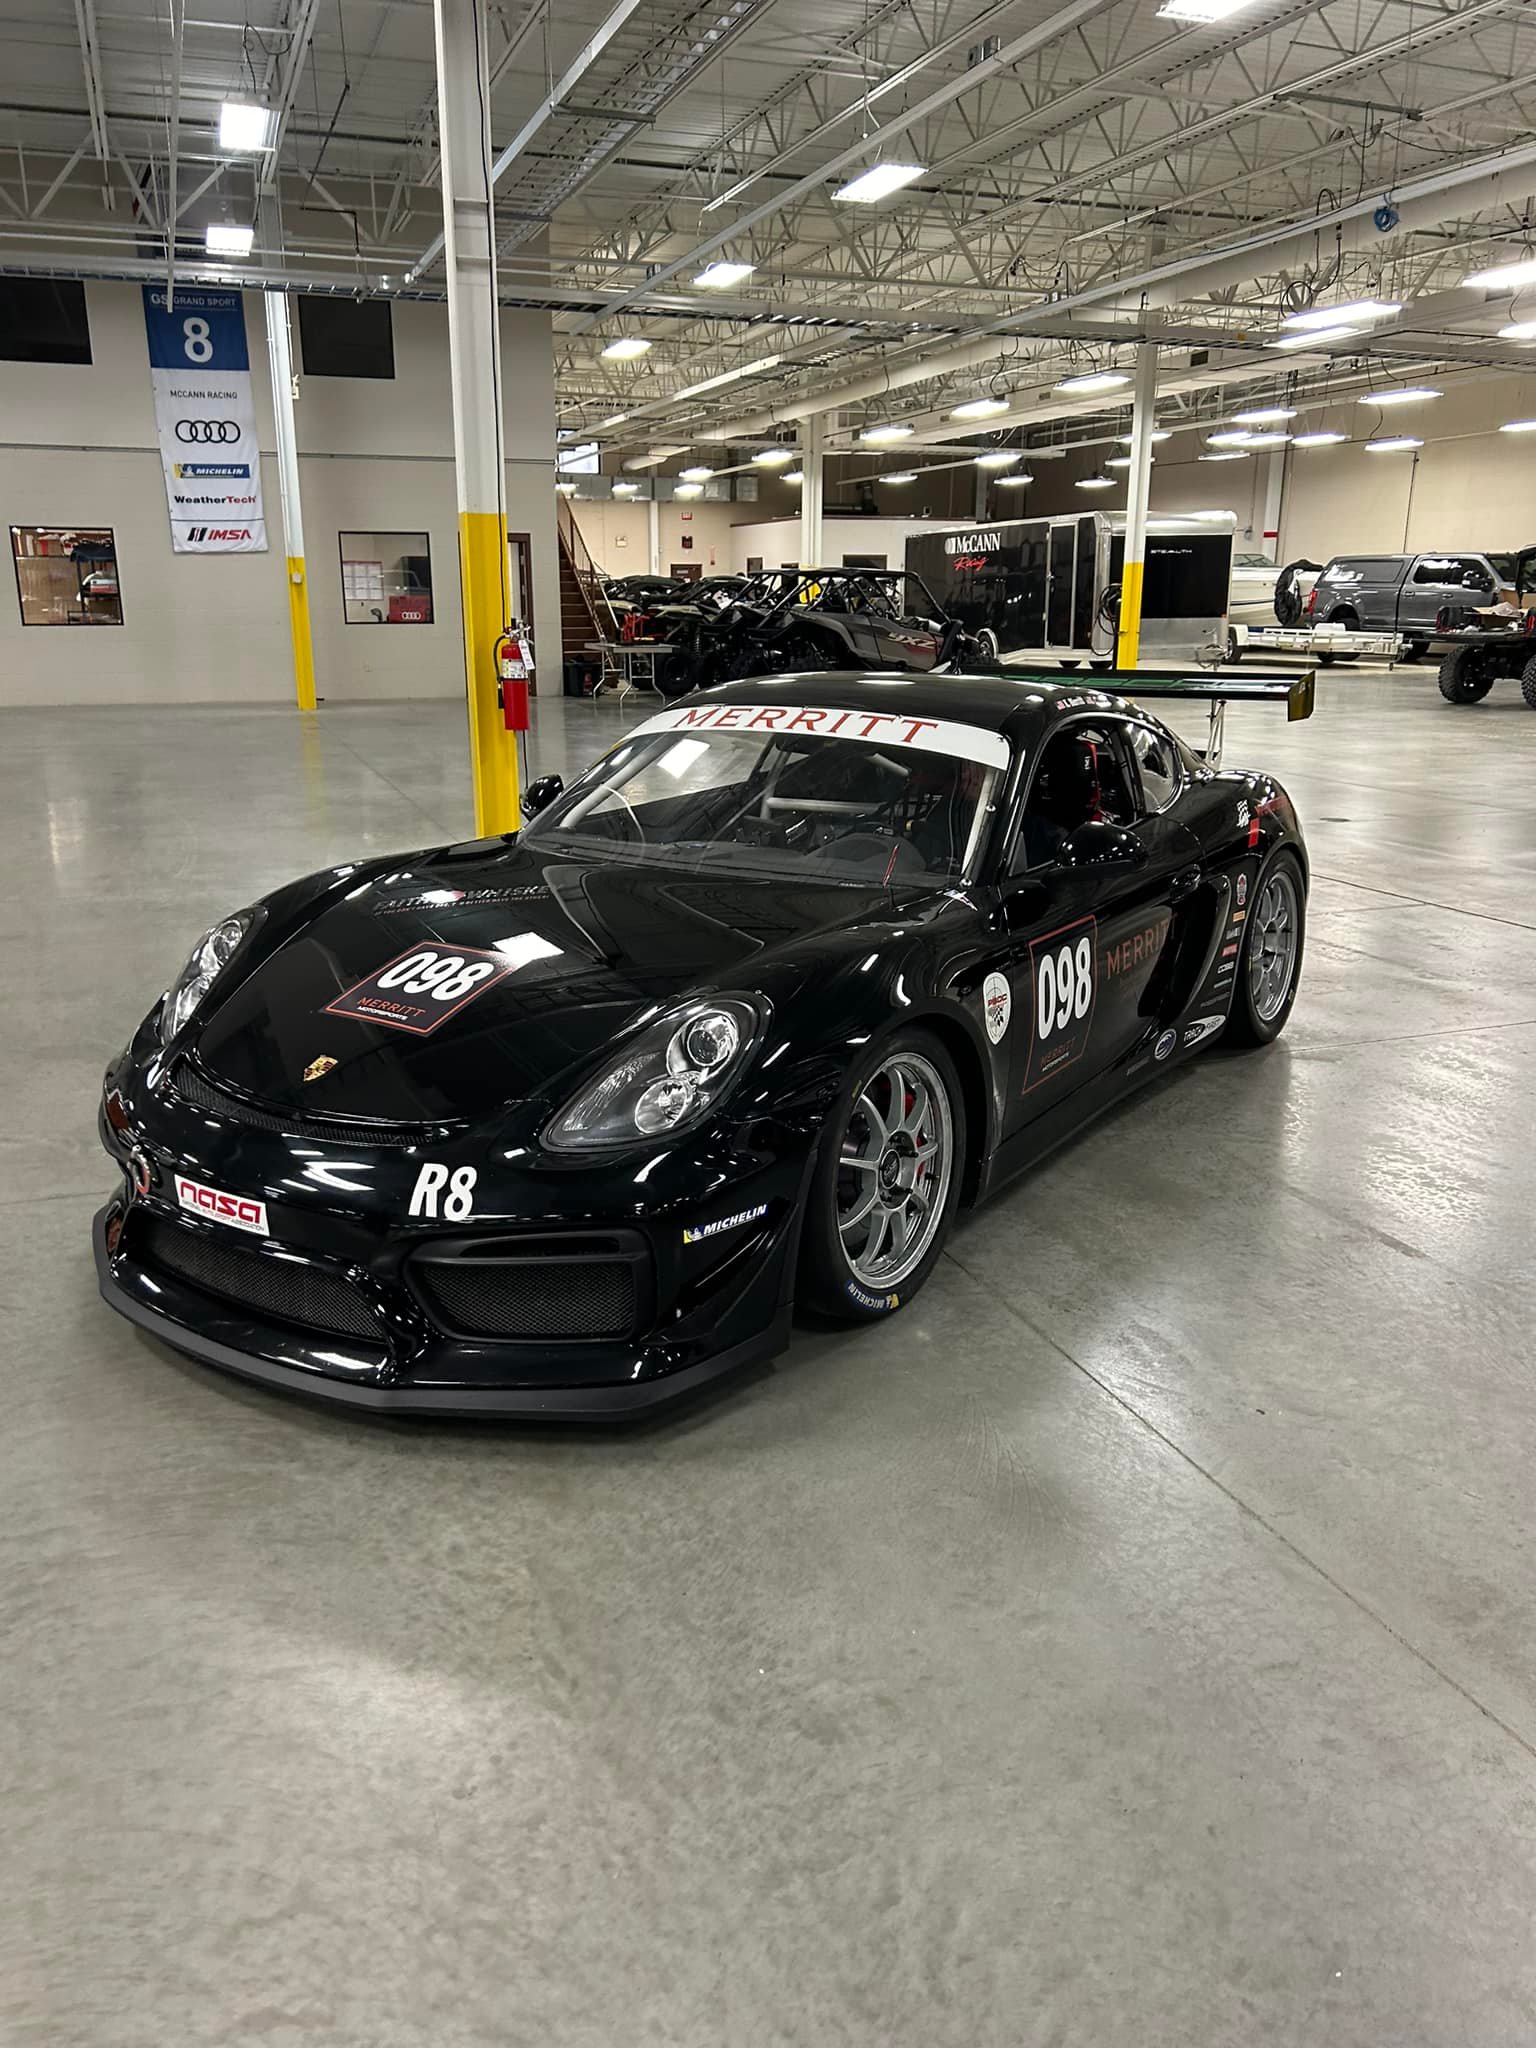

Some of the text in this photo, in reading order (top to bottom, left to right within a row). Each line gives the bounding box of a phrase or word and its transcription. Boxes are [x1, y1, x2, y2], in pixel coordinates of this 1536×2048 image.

[174, 296, 205, 306] GRAND
[207, 298, 236, 307] SPORT
[183, 317, 213, 363] 8
[170, 390, 238, 400] MCCANN RACING
[195, 468, 244, 476] MICHELIN
[174, 495, 256, 504] WeatherTech
[208, 529, 252, 541] IMSA
[957, 532, 1001, 554] McCANN
[670, 707, 939, 744] MERRITT
[377, 951, 495, 1001] 098
[1038, 936, 1092, 1040] 098
[357, 996, 426, 1017] MERRITT
[408, 1162, 478, 1222] R8
[703, 1203, 768, 1236] MICHELIN
[847, 1282, 886, 1309] MICHELIN
